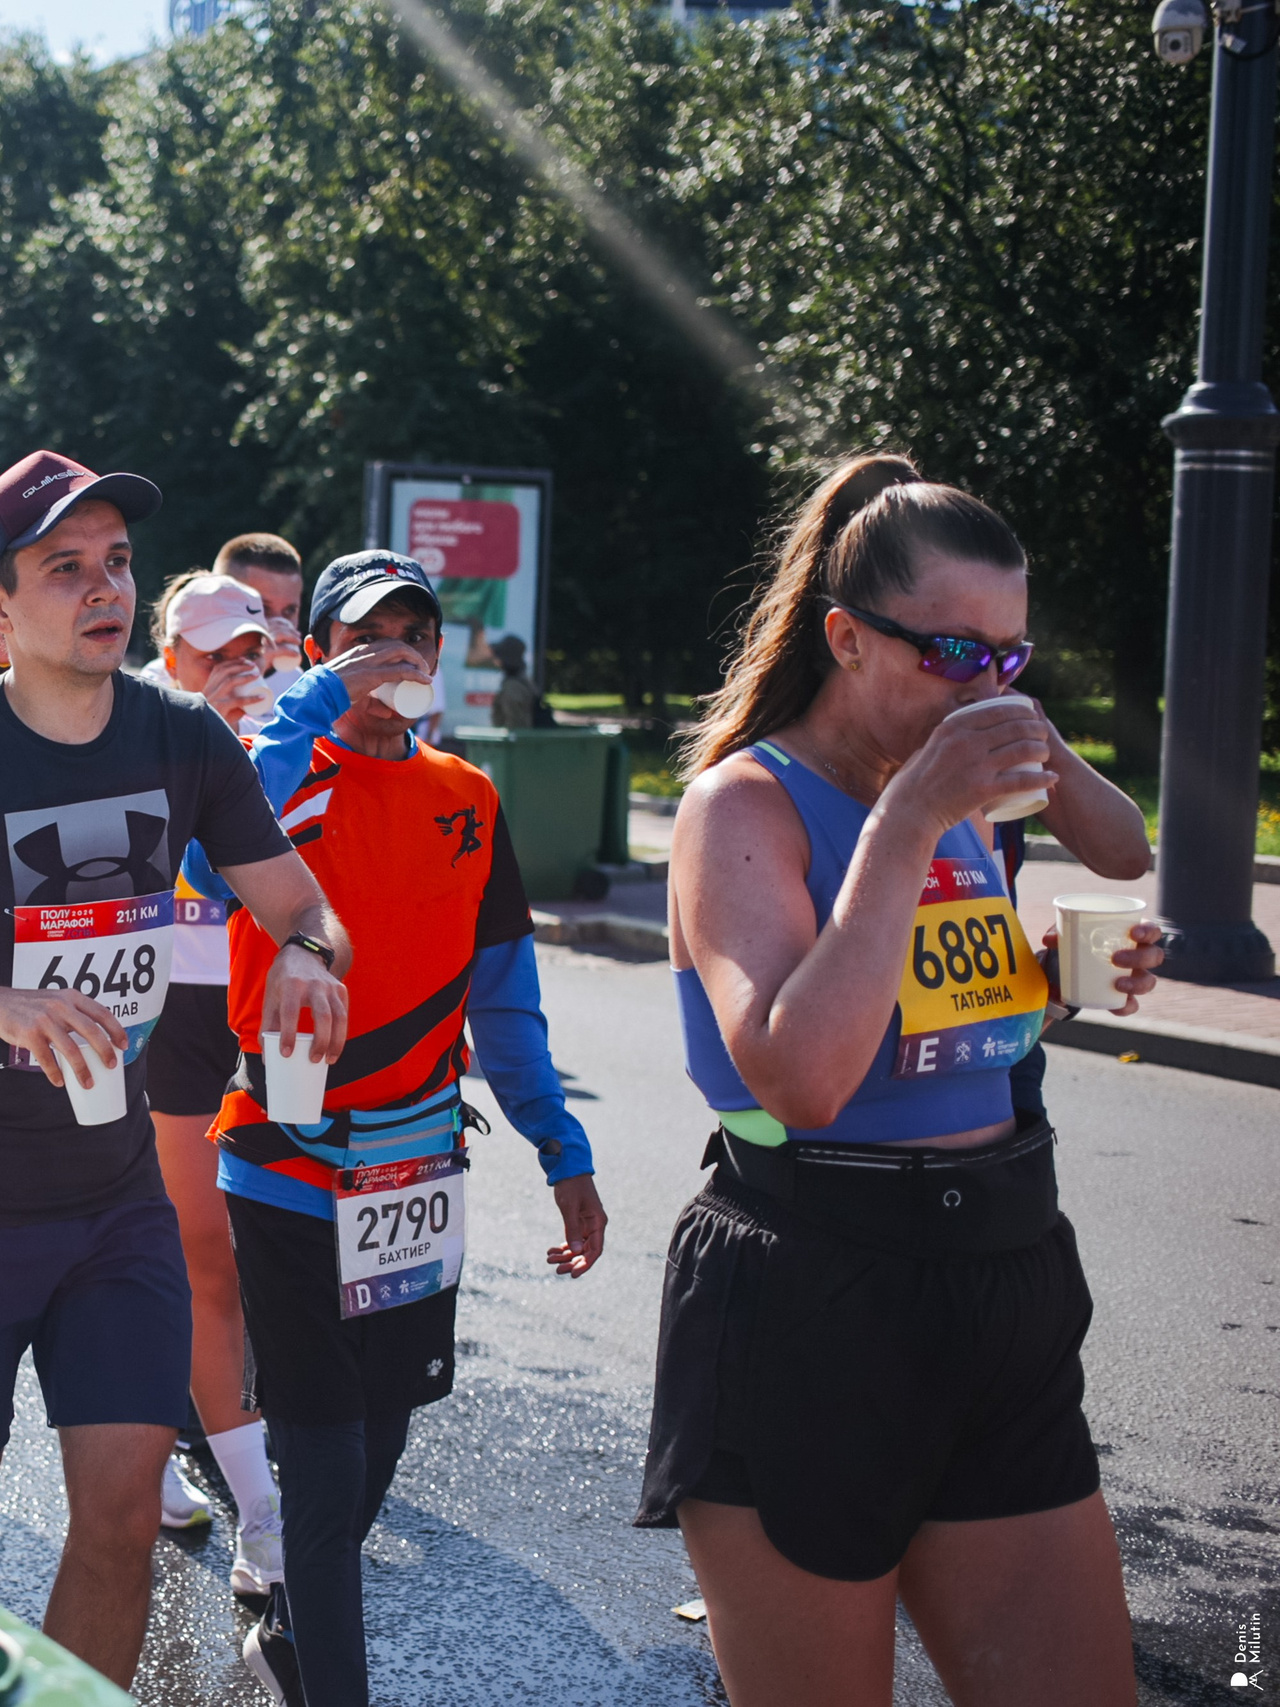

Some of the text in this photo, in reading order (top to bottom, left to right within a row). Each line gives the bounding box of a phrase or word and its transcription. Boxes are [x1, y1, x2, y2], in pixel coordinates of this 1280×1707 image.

[951, 870, 972, 888] 21,1
[40, 909, 71, 920] ПОЛУ
[40, 917, 94, 930] МАРАФОН
[116, 910, 138, 924] 21,1
[185, 901, 200, 922] D
[912, 914, 1017, 990] 6887
[38, 943, 156, 1000] 6648
[951, 984, 1014, 1012] ТАТЬЯНА
[916, 1037, 940, 1073] E
[356, 1191, 449, 1252] 2790
[379, 1241, 431, 1266] БАХТИЕР
[356, 1283, 372, 1310] D
